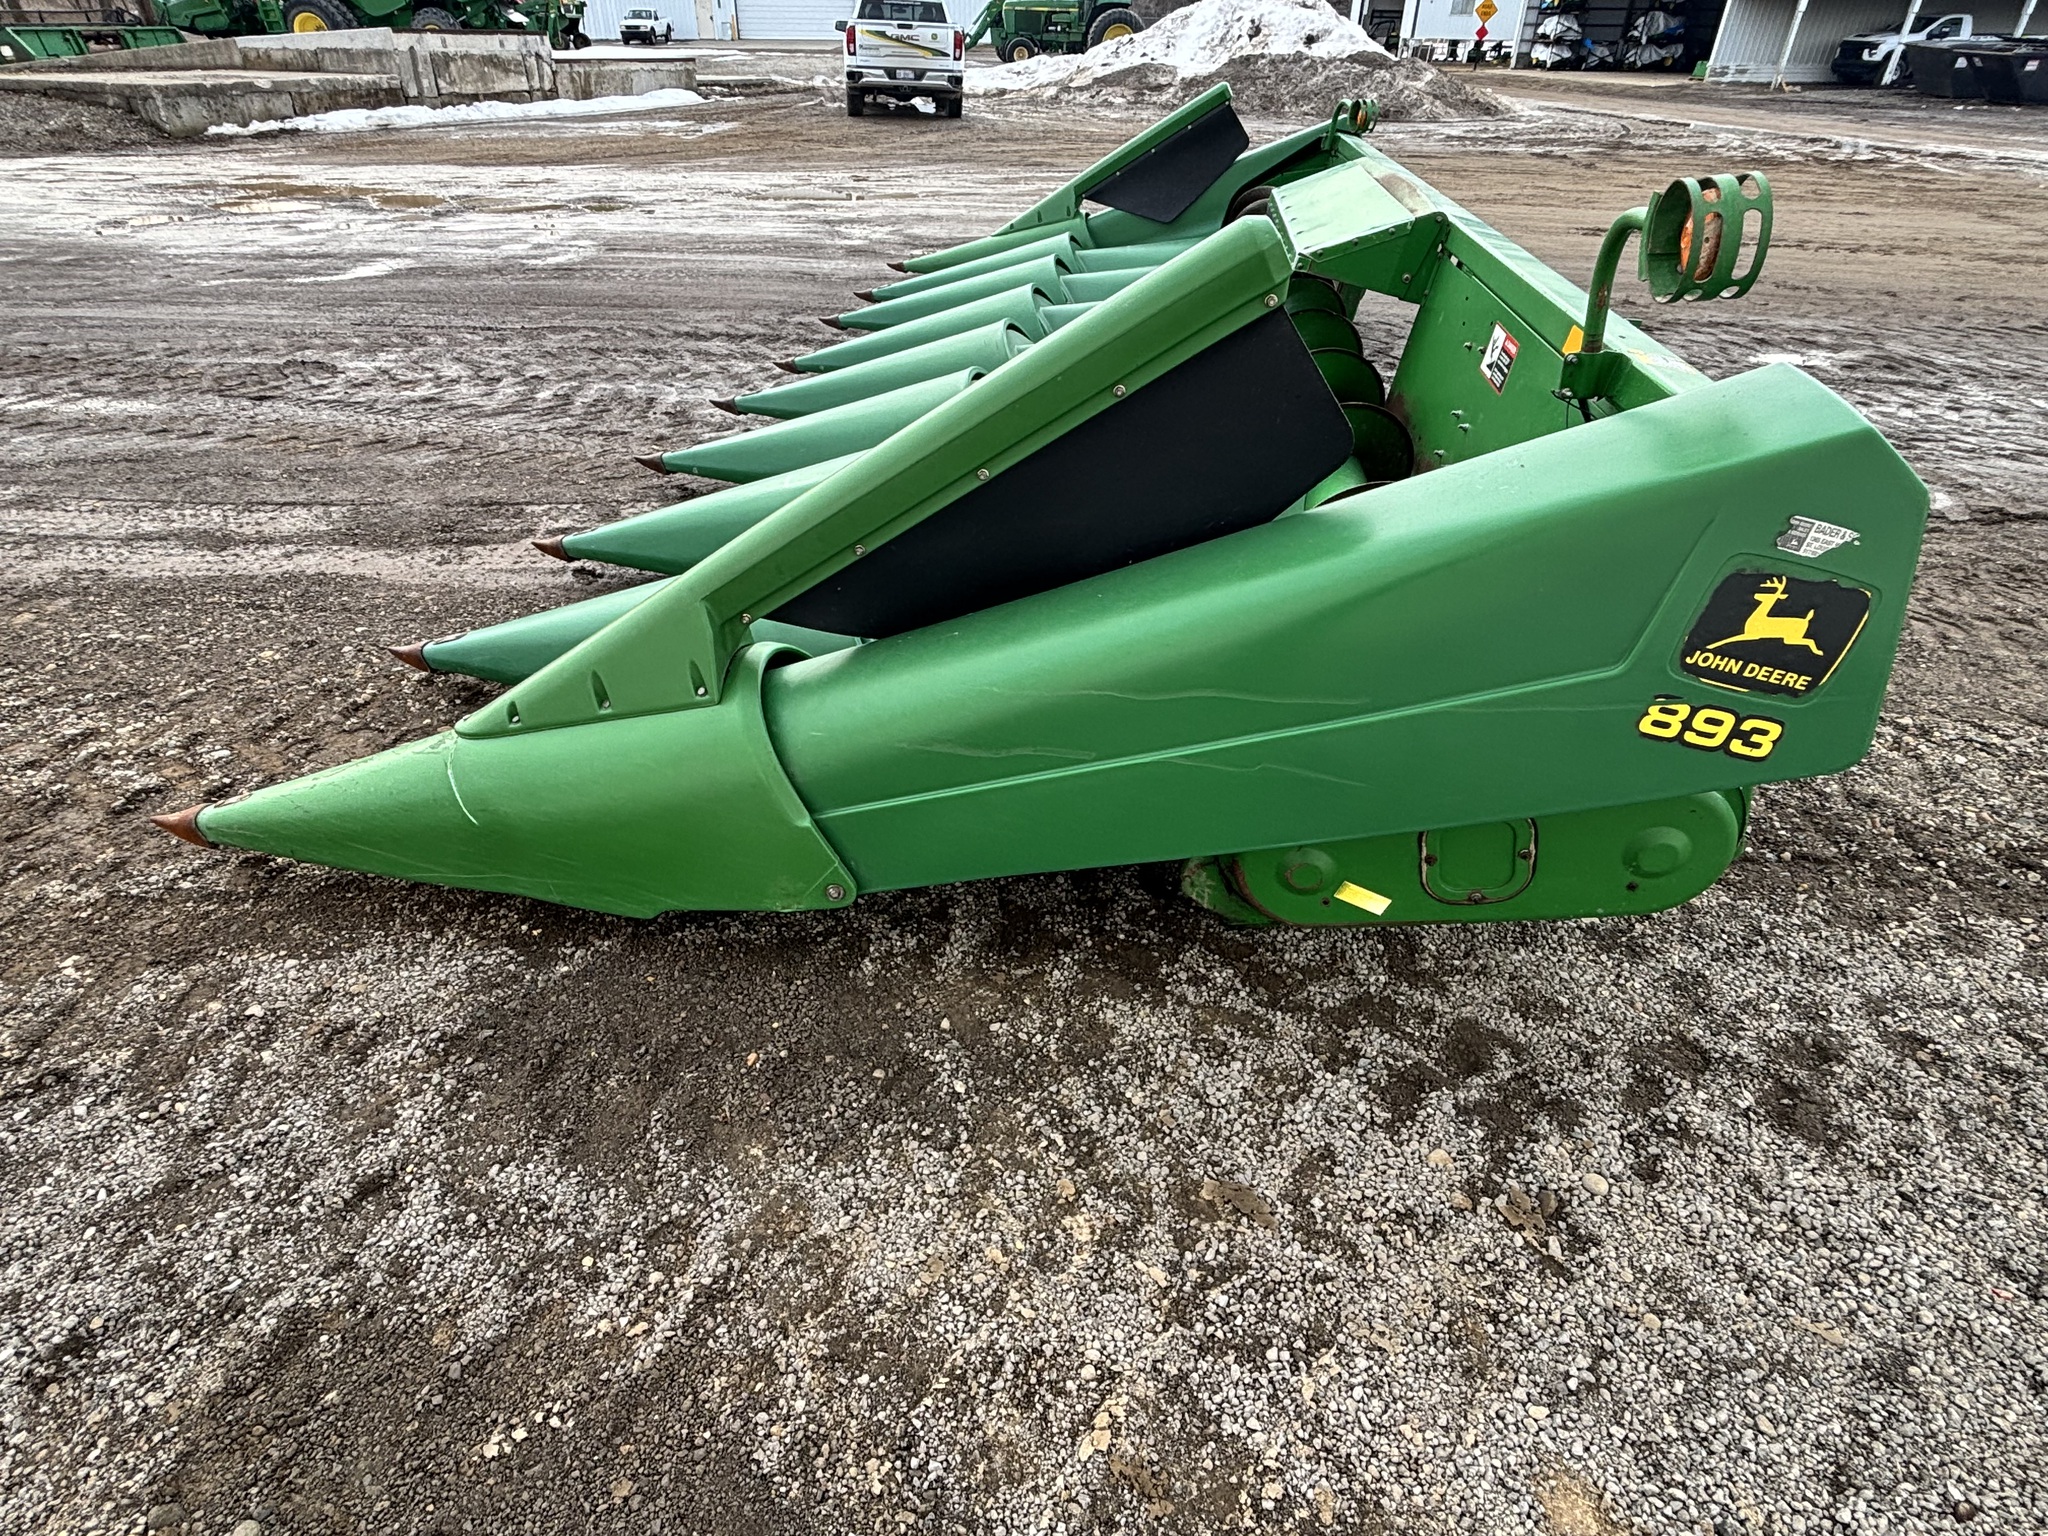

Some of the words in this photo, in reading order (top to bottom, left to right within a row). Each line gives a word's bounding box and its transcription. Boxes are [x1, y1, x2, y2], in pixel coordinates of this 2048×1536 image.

[891, 33, 920, 42] GMC
[1814, 524, 1842, 538] BADER
[1839, 530, 1848, 540] &
[1685, 650, 1744, 675] JOHN
[1742, 663, 1812, 691] DEERE
[1637, 702, 1784, 759] 893
